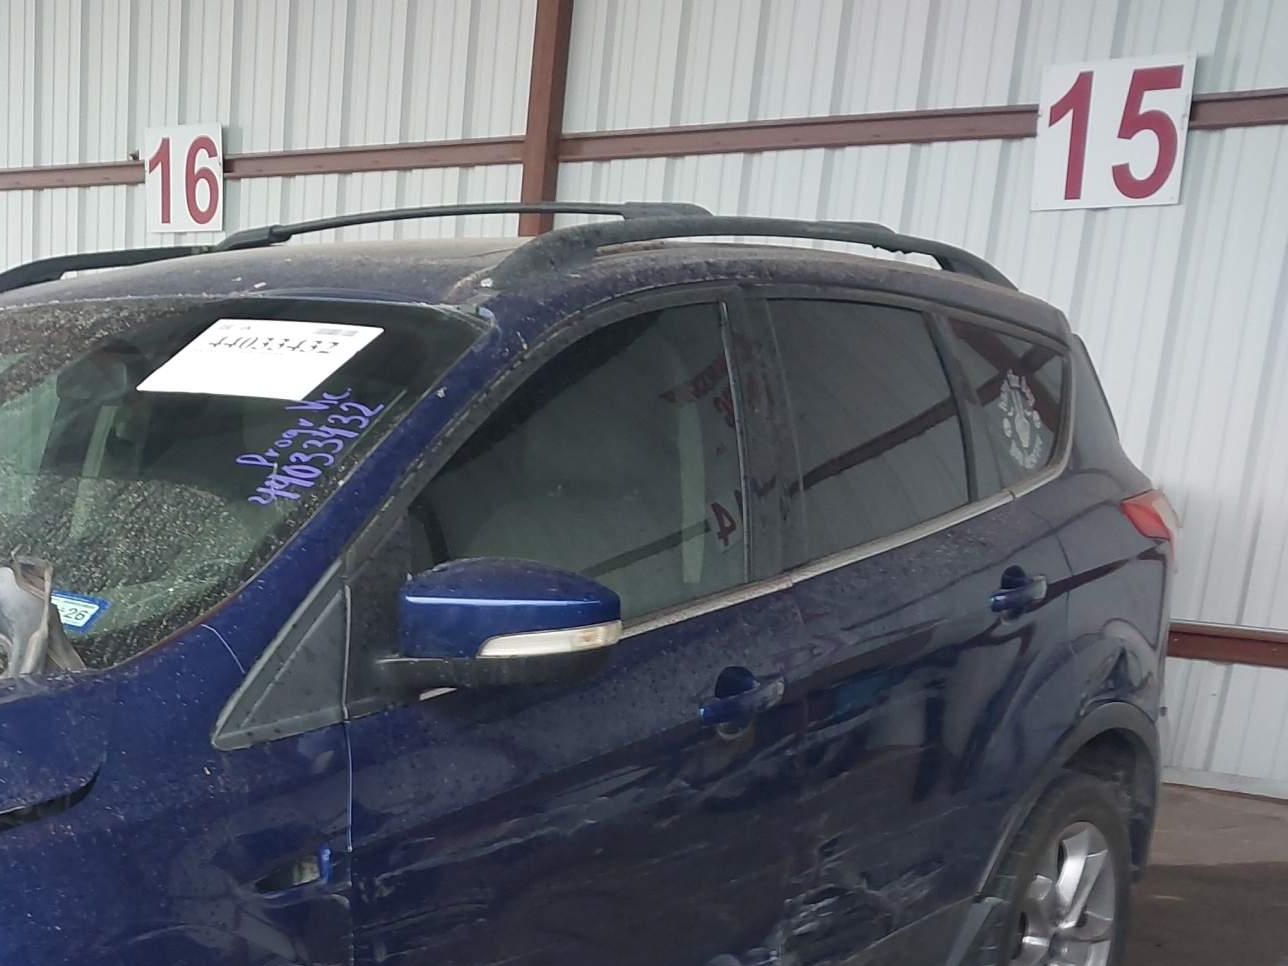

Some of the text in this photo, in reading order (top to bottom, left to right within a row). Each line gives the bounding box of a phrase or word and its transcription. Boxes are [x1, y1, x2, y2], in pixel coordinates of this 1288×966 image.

[149, 135, 219, 224] 16
[1048, 65, 1184, 200] 15
[248, 401, 384, 504] 44033432
